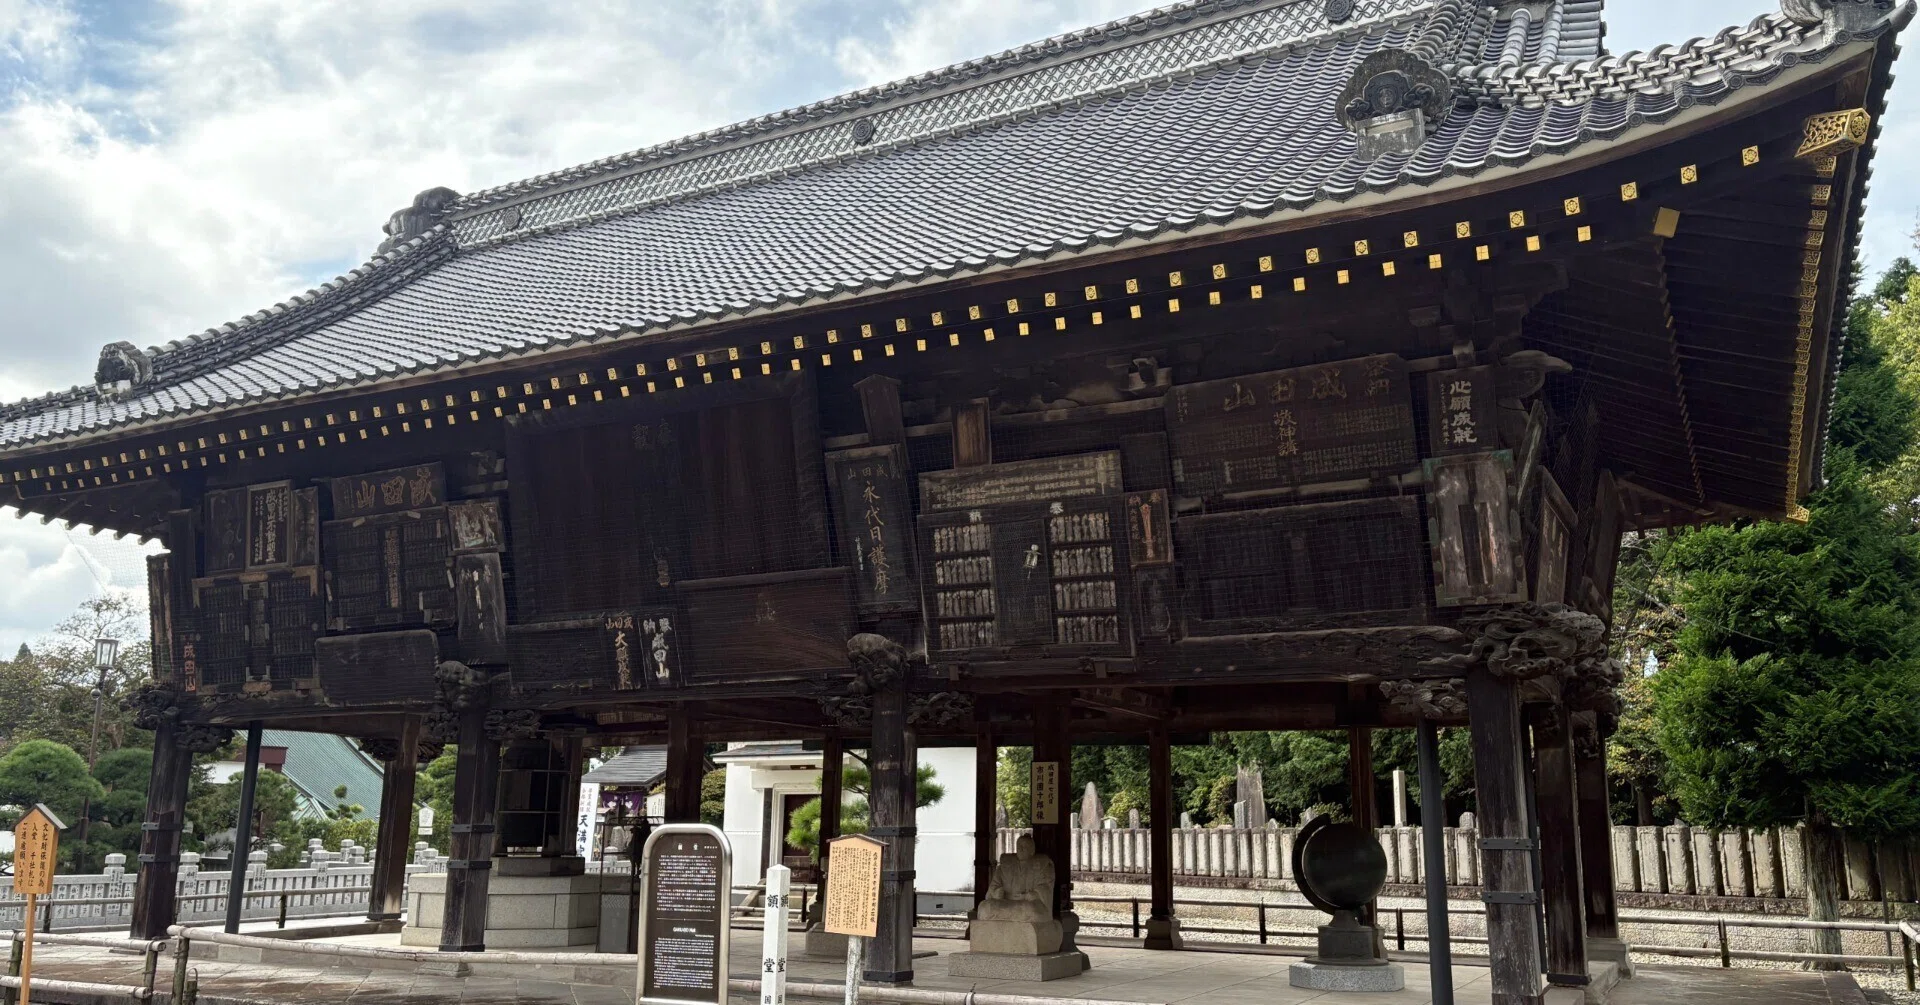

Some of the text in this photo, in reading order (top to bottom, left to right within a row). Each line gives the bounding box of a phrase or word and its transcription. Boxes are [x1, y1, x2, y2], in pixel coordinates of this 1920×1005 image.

[847, 463, 889, 480] 成田山
[862, 480, 890, 595] 永代日護摩
